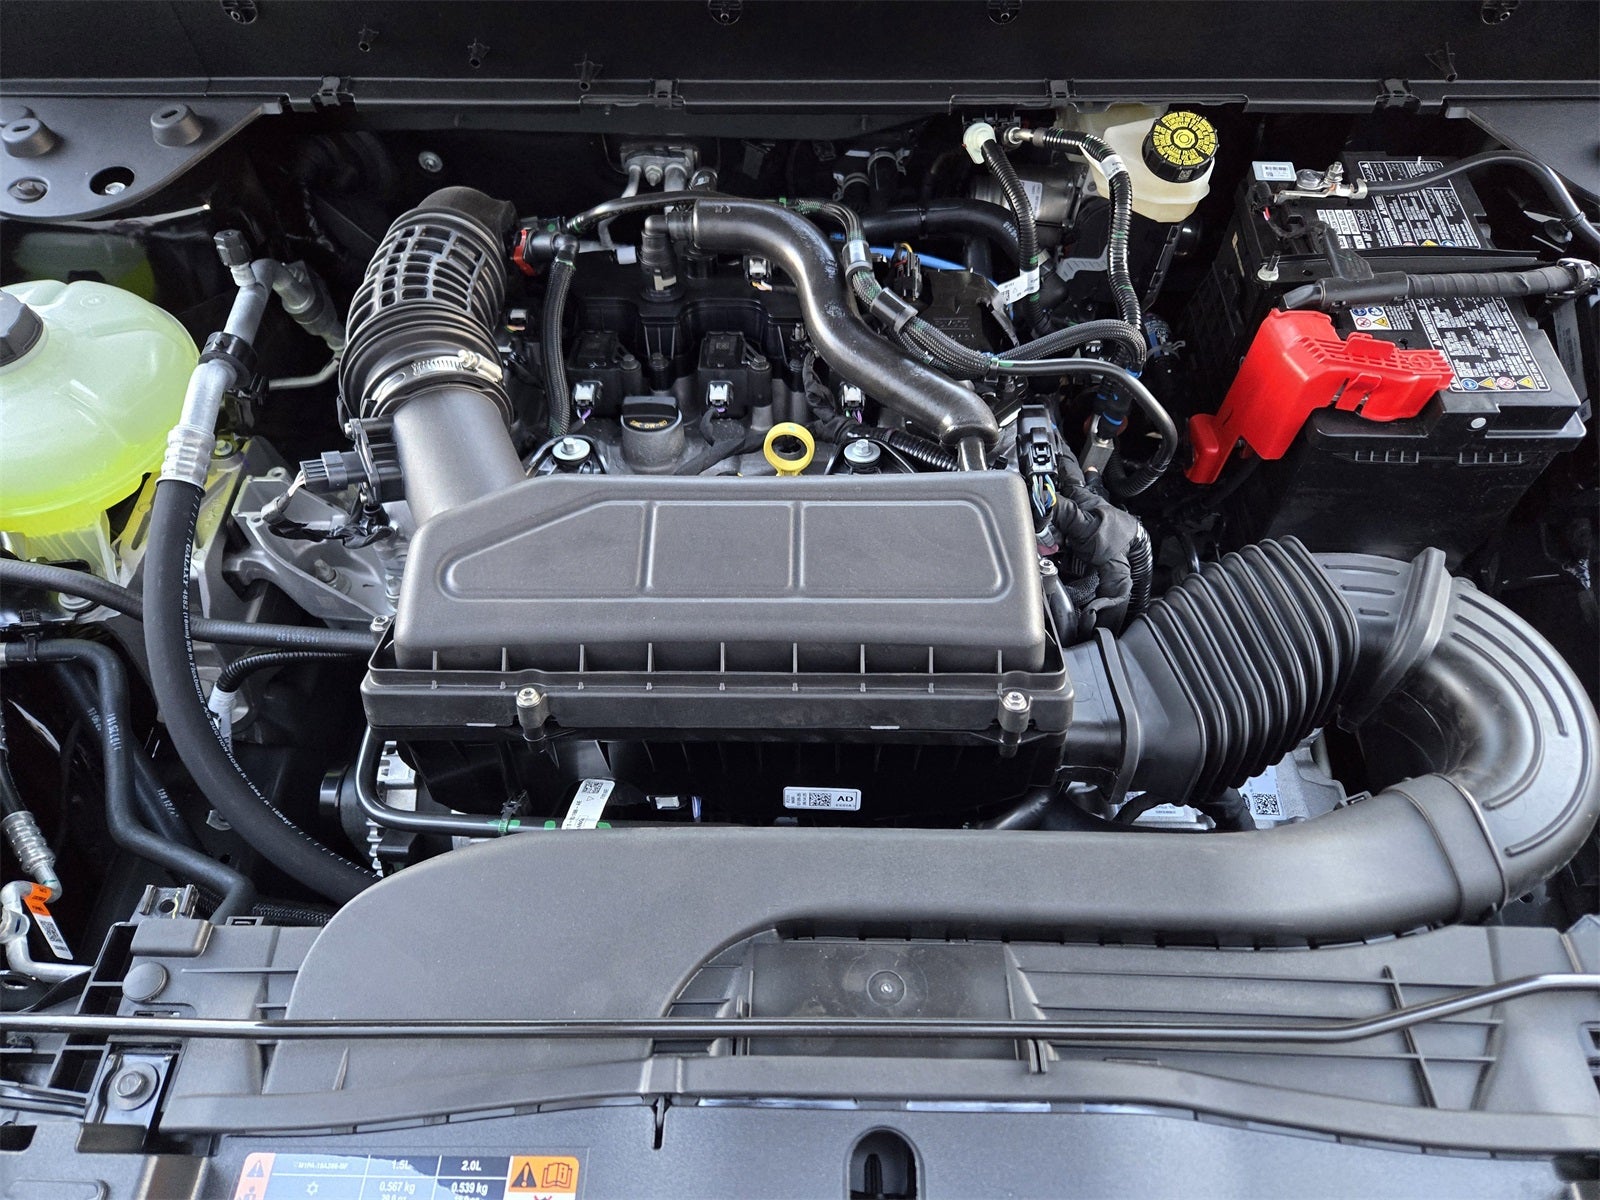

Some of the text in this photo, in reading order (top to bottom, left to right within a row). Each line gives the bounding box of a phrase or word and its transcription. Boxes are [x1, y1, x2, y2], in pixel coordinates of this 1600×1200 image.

[182, 543, 191, 588] GALAXY
[209, 720, 229, 753] SUCTION
[226, 752, 243, 773] HOSE
[837, 795, 854, 803] AD
[391, 1159, 411, 1171] 1.5L
[461, 1160, 482, 1172] 2.0L
[379, 1181, 416, 1195] 0.567 kg
[451, 1181, 489, 1197] 0.539 kg
